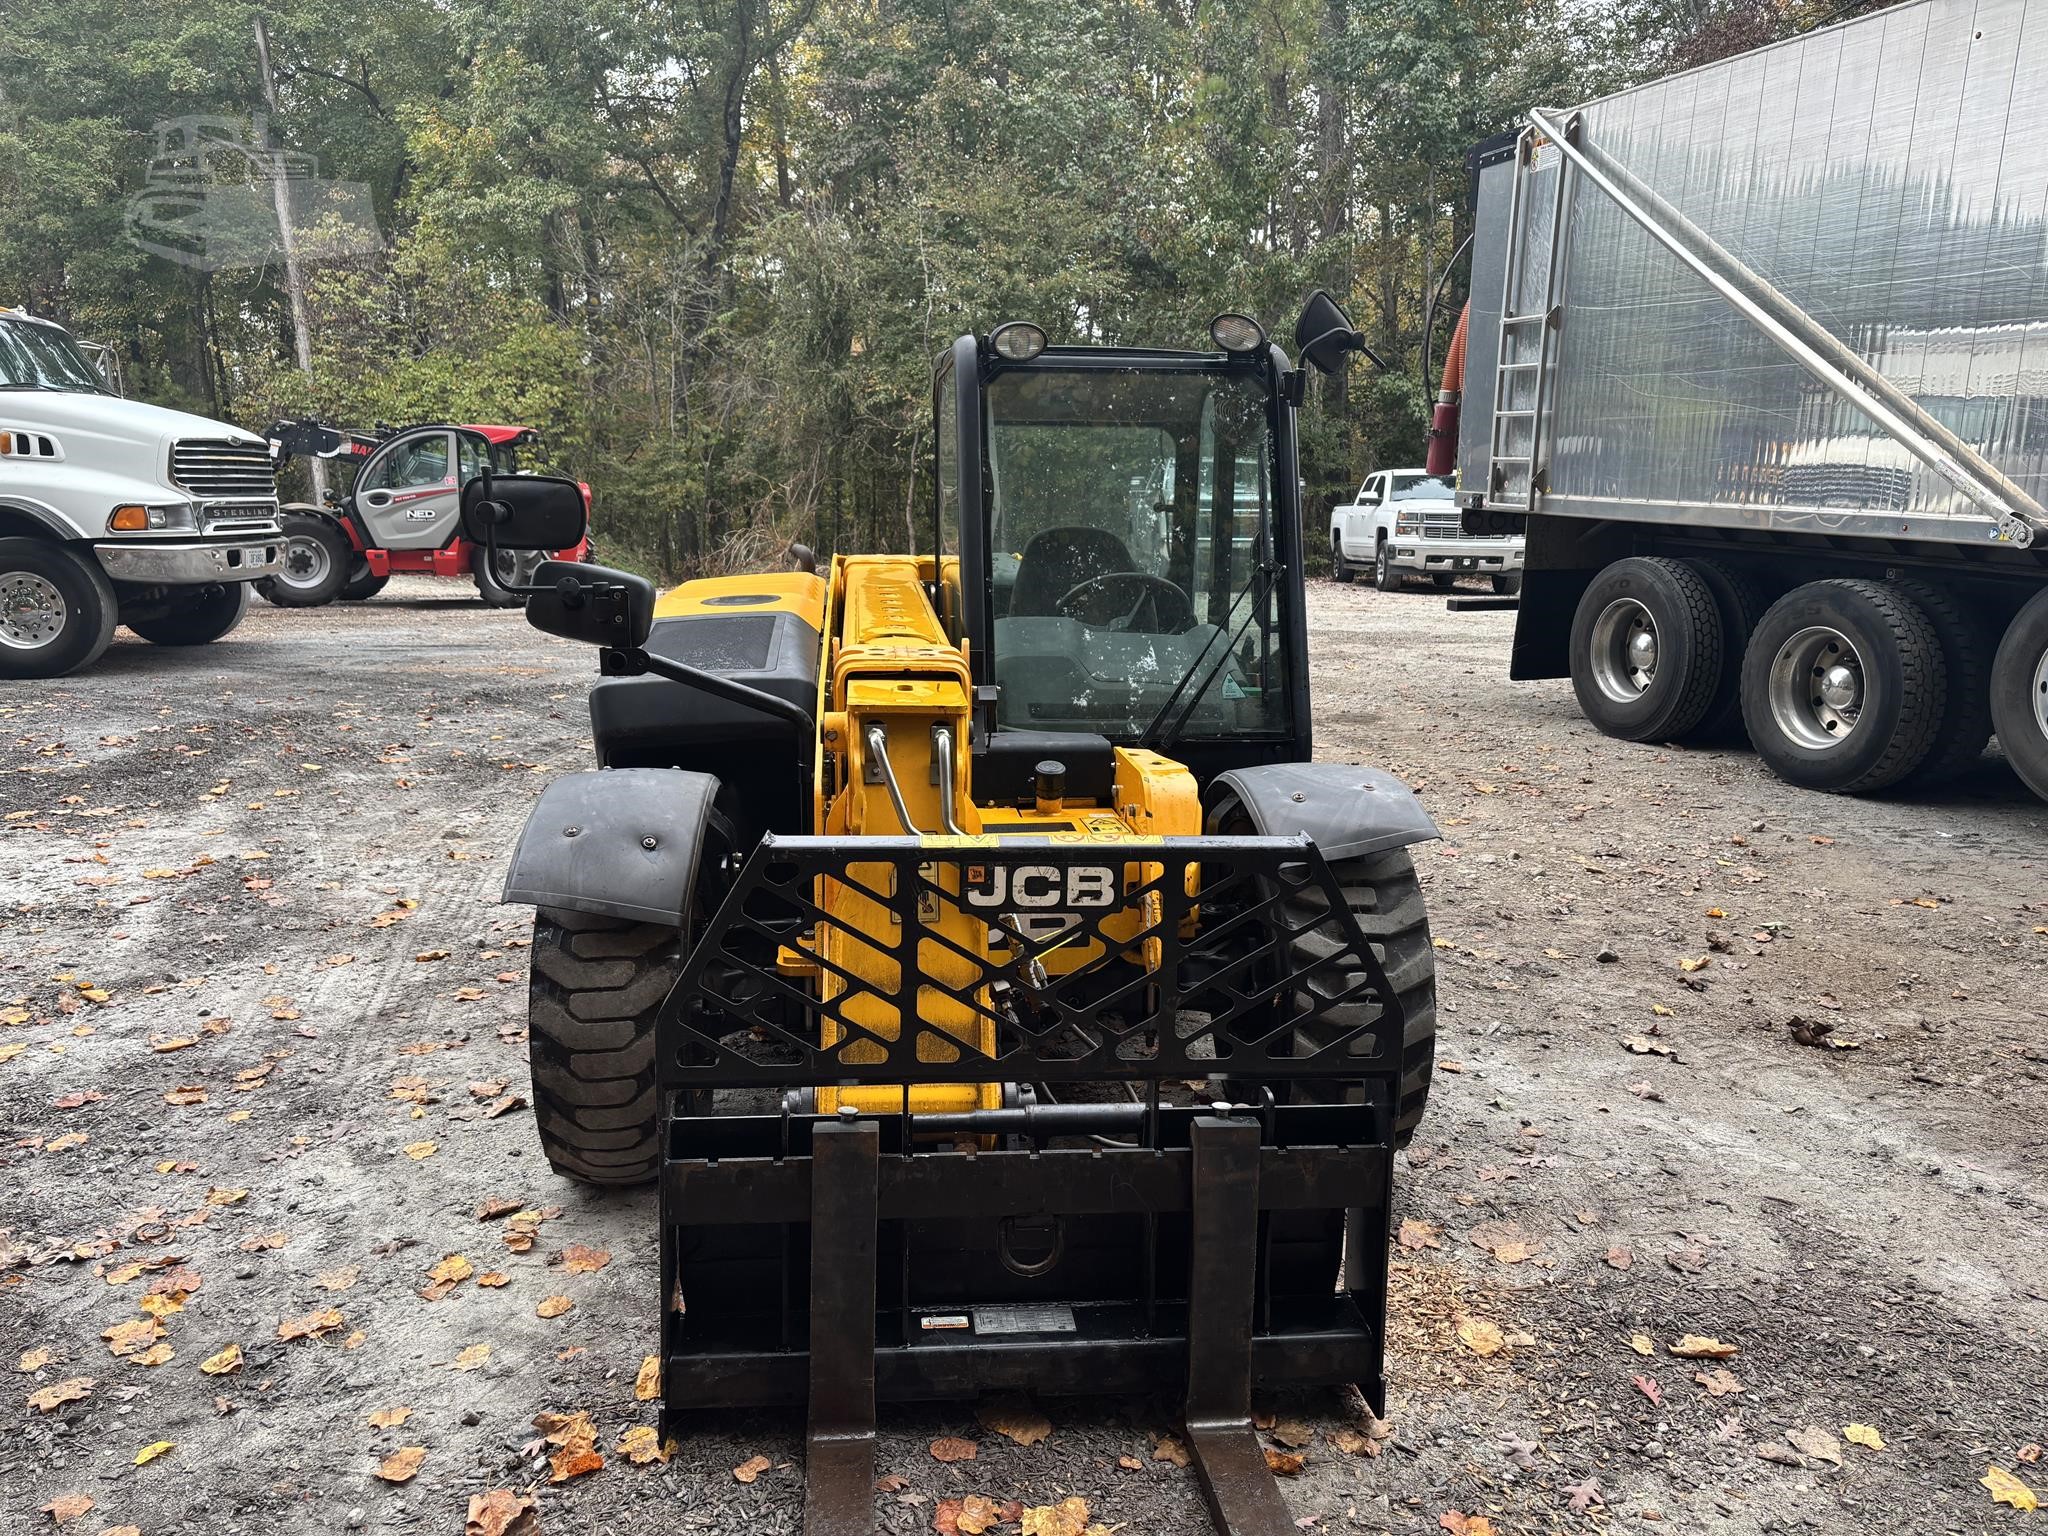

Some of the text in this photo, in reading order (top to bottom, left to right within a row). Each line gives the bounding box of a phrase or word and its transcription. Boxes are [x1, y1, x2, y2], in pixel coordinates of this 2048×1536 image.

[213, 508, 268, 517] STERLING
[406, 509, 436, 519] NED
[967, 866, 1115, 907] JCB
